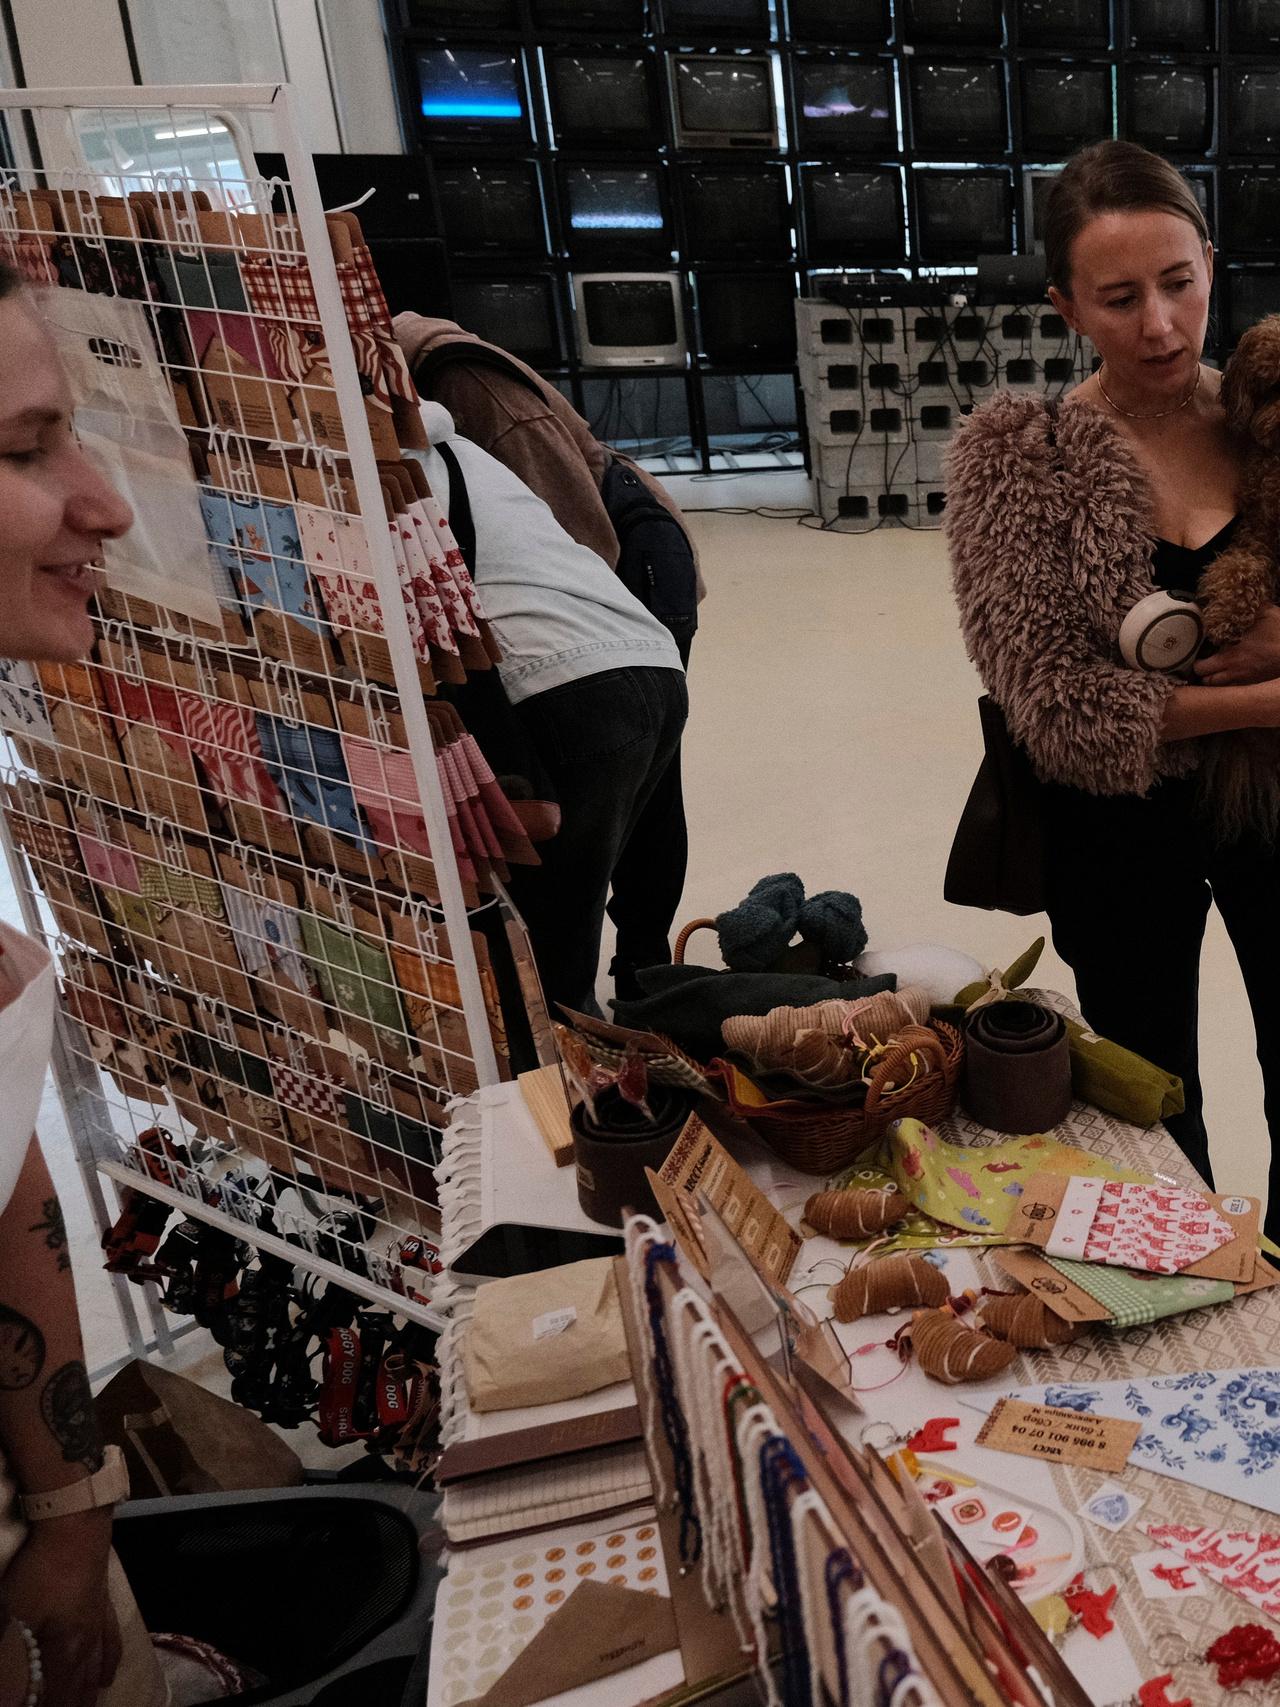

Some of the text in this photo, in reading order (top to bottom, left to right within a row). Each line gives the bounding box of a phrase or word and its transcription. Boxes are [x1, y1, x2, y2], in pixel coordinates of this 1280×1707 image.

[385, 1384, 399, 1409] DOG
[1023, 1415, 1052, 1427] Сбер
[1044, 1409, 1103, 1425] Александра
[1012, 1425, 1027, 1434] 04
[1029, 1429, 1044, 1438] 07
[1048, 1432, 1070, 1443] 901
[1098, 1441, 1106, 1449] 8
